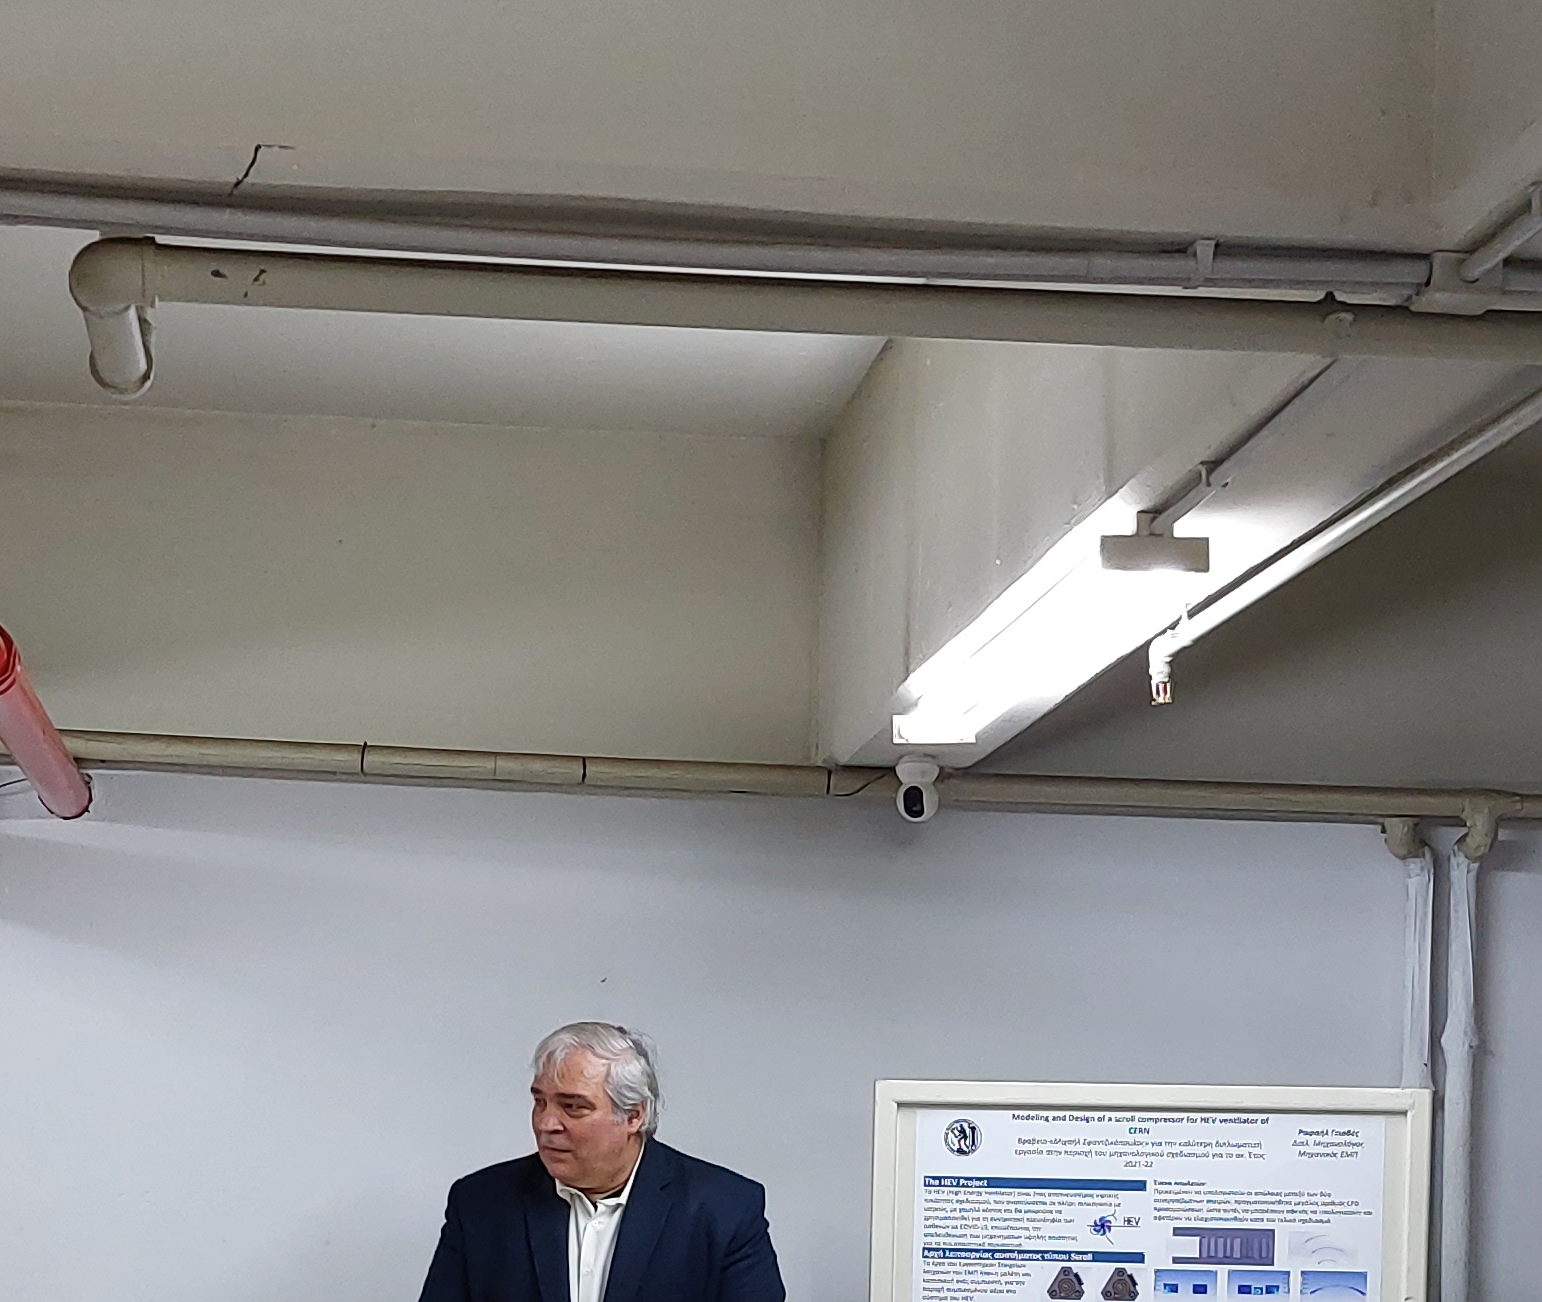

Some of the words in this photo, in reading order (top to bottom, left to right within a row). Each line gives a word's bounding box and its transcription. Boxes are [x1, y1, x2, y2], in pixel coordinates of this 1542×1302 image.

[1012, 1113, 1050, 1123] Modeling
[1051, 1114, 1067, 1122] and
[1068, 1114, 1095, 1123] Design
[1097, 1114, 1106, 1122] of
[1114, 1115, 1136, 1123] scroll
[1137, 1116, 1185, 1126] compressor
[1186, 1116, 1198, 1124] for
[1200, 1116, 1217, 1125] HEV
[1218, 1117, 1258, 1125] ventilator
[1260, 1117, 1270, 1125] of
[1128, 1127, 1150, 1135] CERN
[924, 1177, 940, 1187] The
[941, 1178, 958, 1187] HEV
[959, 1178, 988, 1188] Project
[1123, 1216, 1141, 1226] HEV
[923, 1248, 944, 1259] Αρχή
[1070, 1253, 1093, 1262] Scroll
